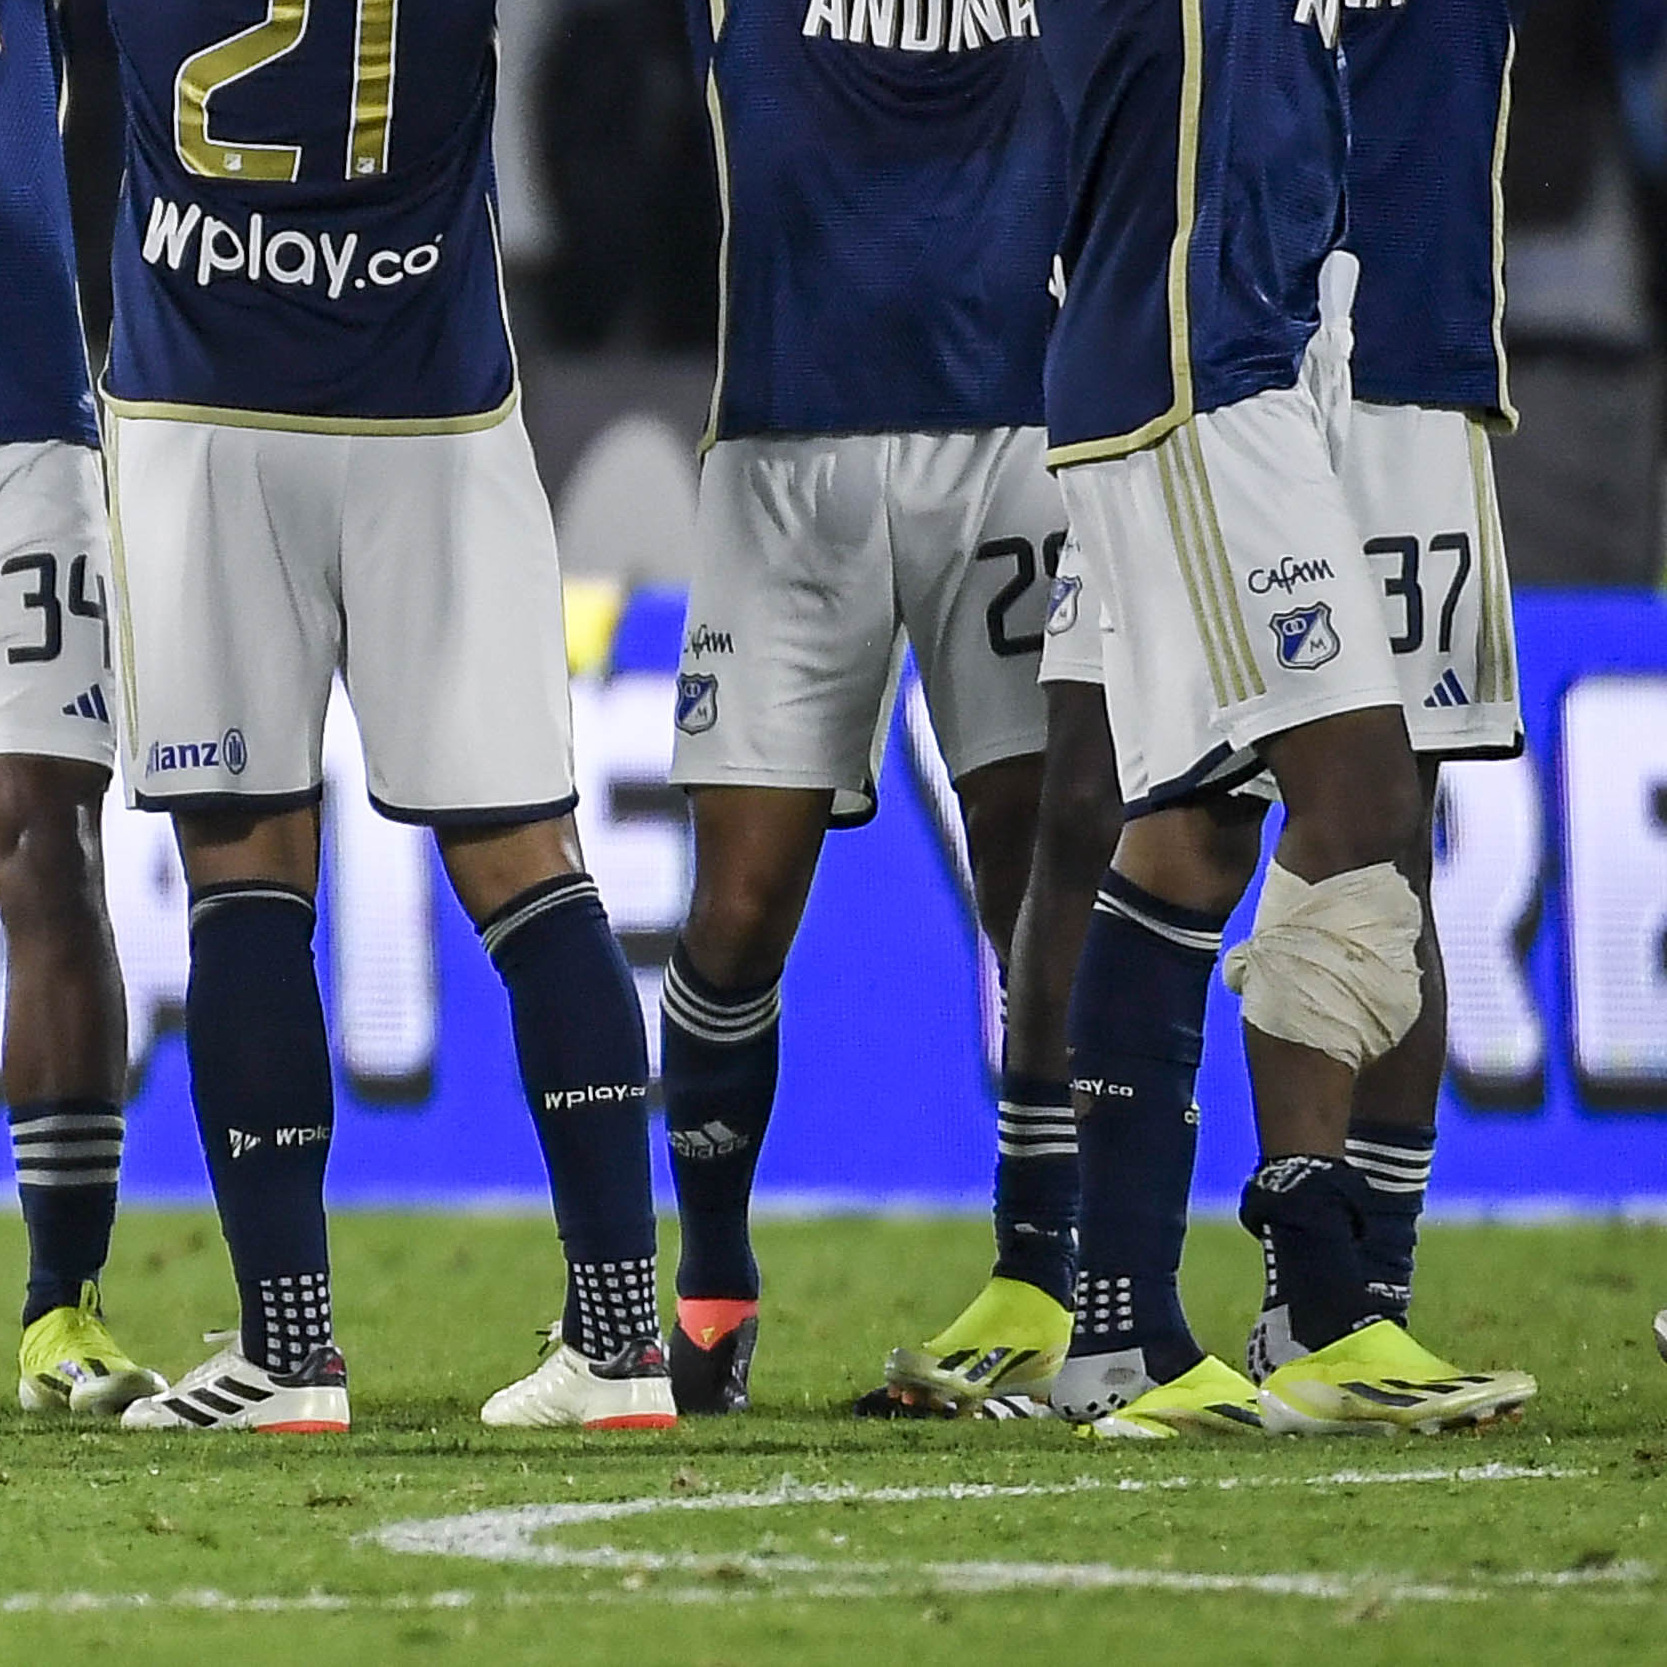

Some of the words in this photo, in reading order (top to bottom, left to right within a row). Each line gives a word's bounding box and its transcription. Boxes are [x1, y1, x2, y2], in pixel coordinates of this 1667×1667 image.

[142, 197, 444, 297] Wplay.co
[1, 552, 112, 669] 34
[1364, 532, 1469, 654] 37
